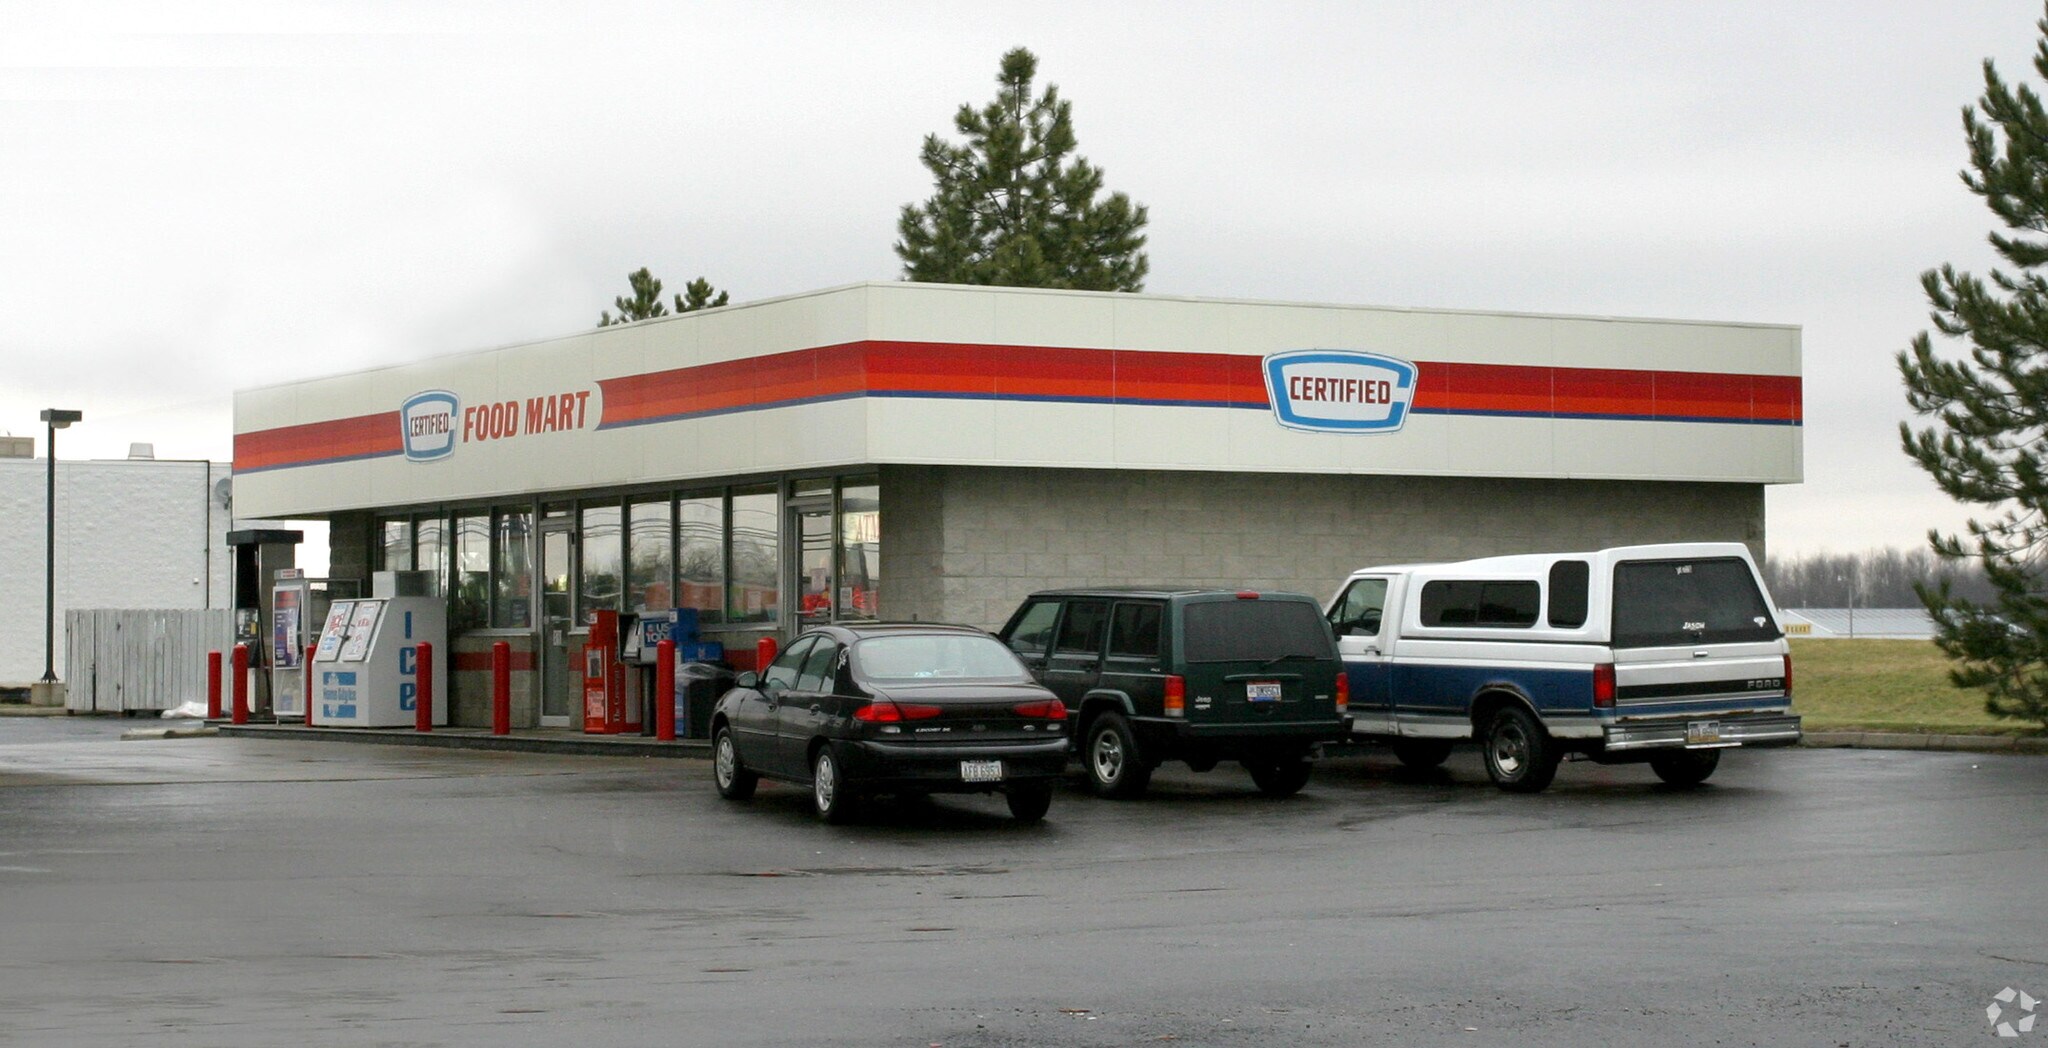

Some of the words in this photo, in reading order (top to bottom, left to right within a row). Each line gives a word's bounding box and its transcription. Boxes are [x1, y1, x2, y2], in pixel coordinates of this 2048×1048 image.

[1290, 376, 1391, 404] CERTIFIED
[410, 411, 449, 437] CERTIFIED
[463, 401, 519, 443] FOOD
[524, 391, 590, 435] MART
[1682, 621, 1705, 630] JASON
[1747, 680, 1780, 689] FORD
[1195, 695, 1212, 703] Jeep
